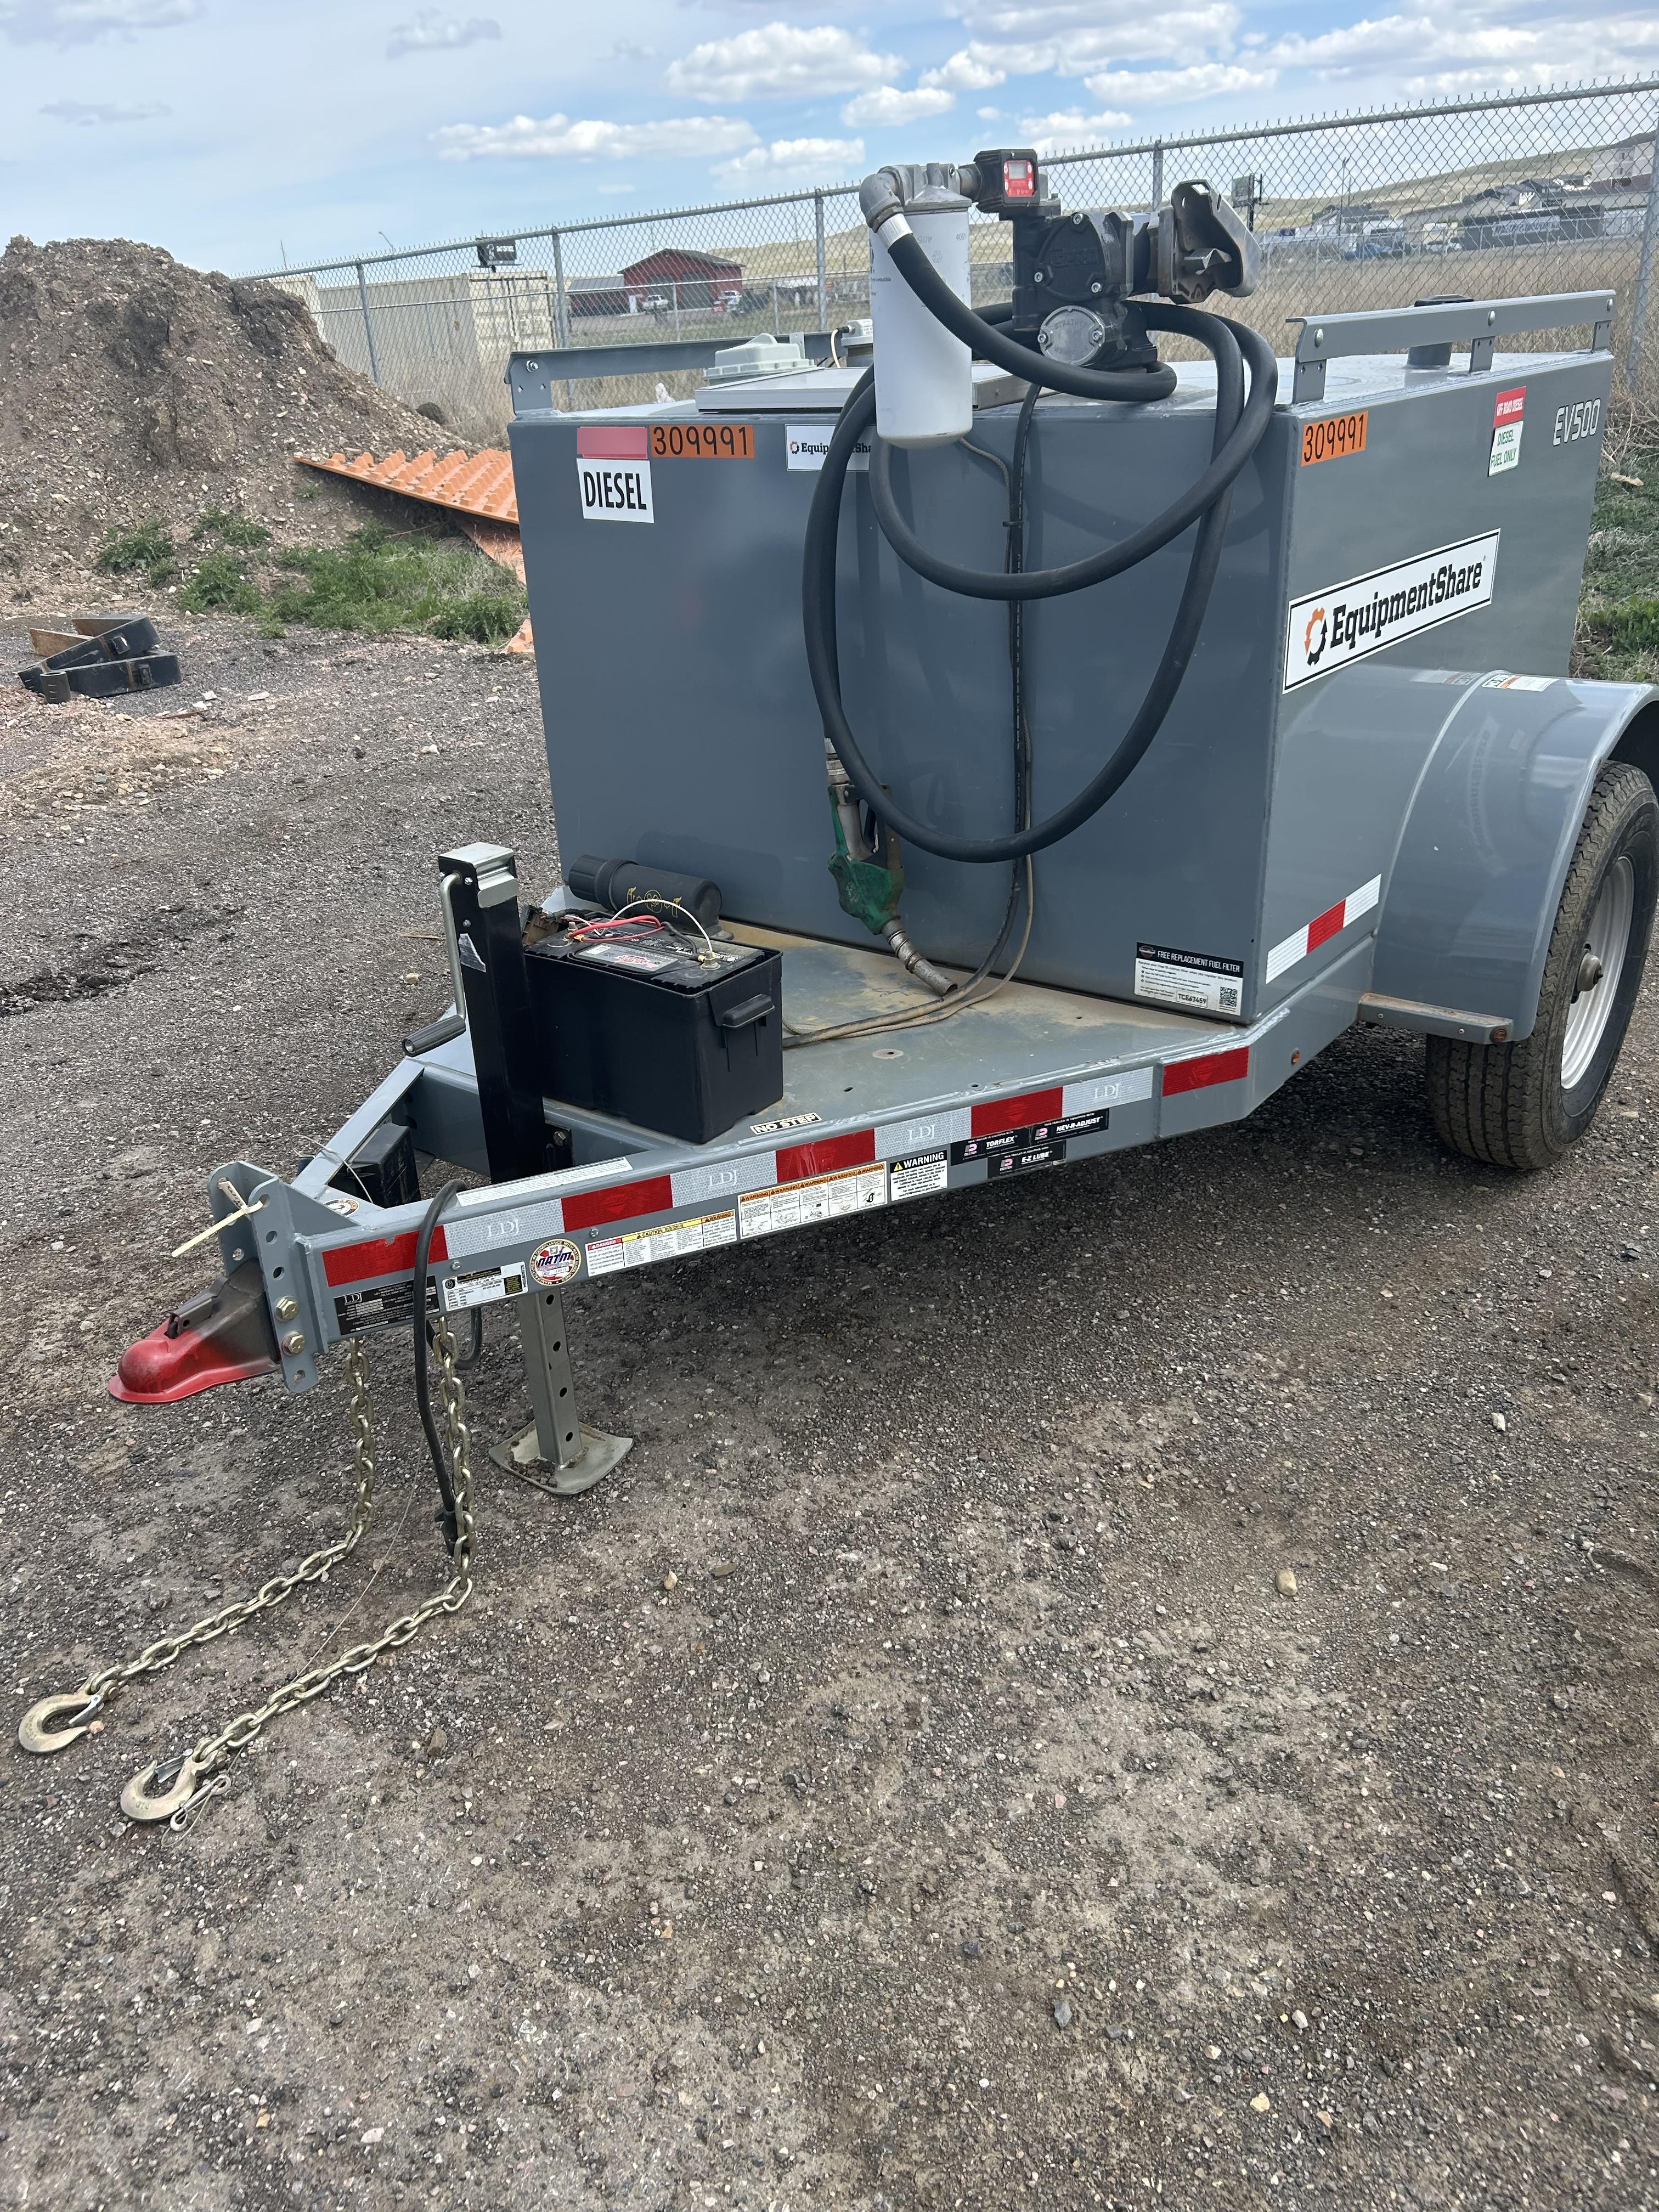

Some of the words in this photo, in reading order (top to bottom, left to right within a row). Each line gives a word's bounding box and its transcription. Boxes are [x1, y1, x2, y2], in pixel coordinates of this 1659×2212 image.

[1553, 397, 1601, 447] EV500
[653, 426, 748, 455] 309991
[1304, 414, 1364, 462] 309991
[1497, 429, 1514, 446] DIESEL
[1490, 453, 1502, 468] FUEL
[1504, 448, 1517, 463] ONLY
[583, 471, 647, 510] DIESEL
[1329, 561, 1482, 651] EquipmentShare
[1157, 950, 1170, 960] FREE
[1171, 953, 1209, 967] REPLACEMENT
[1209, 961, 1222, 970] FUEL
[1222, 963, 1240, 973] FILTER
[1093, 1083, 1120, 1099] LDJ
[754, 1122, 780, 1134] NO
[781, 1113, 817, 1128] STEP
[1056, 1116, 1101, 1132] NEV-R-ADJUST
[909, 1124, 935, 1141] LDJ
[986, 1136, 1015, 1148] TORFLEX
[903, 1152, 944, 1169] WARNING
[1032, 1152, 1049, 1160] LUBE
[833, 1172, 856, 1180] WARNING
[861, 1165, 884, 1173] WARNING
[708, 1171, 738, 1188] LDJ
[804, 1178, 828, 1187] WARNING
[745, 1192, 769, 1200] WARNING
[775, 1185, 798, 1194] WARNING
[709, 1212, 732, 1222] WARNING
[488, 1219, 520, 1237] LDJ
[642, 1228, 663, 1238] CAUTION
[596, 1239, 617, 1249] DANGER
[343, 1293, 363, 1304] LDJ
